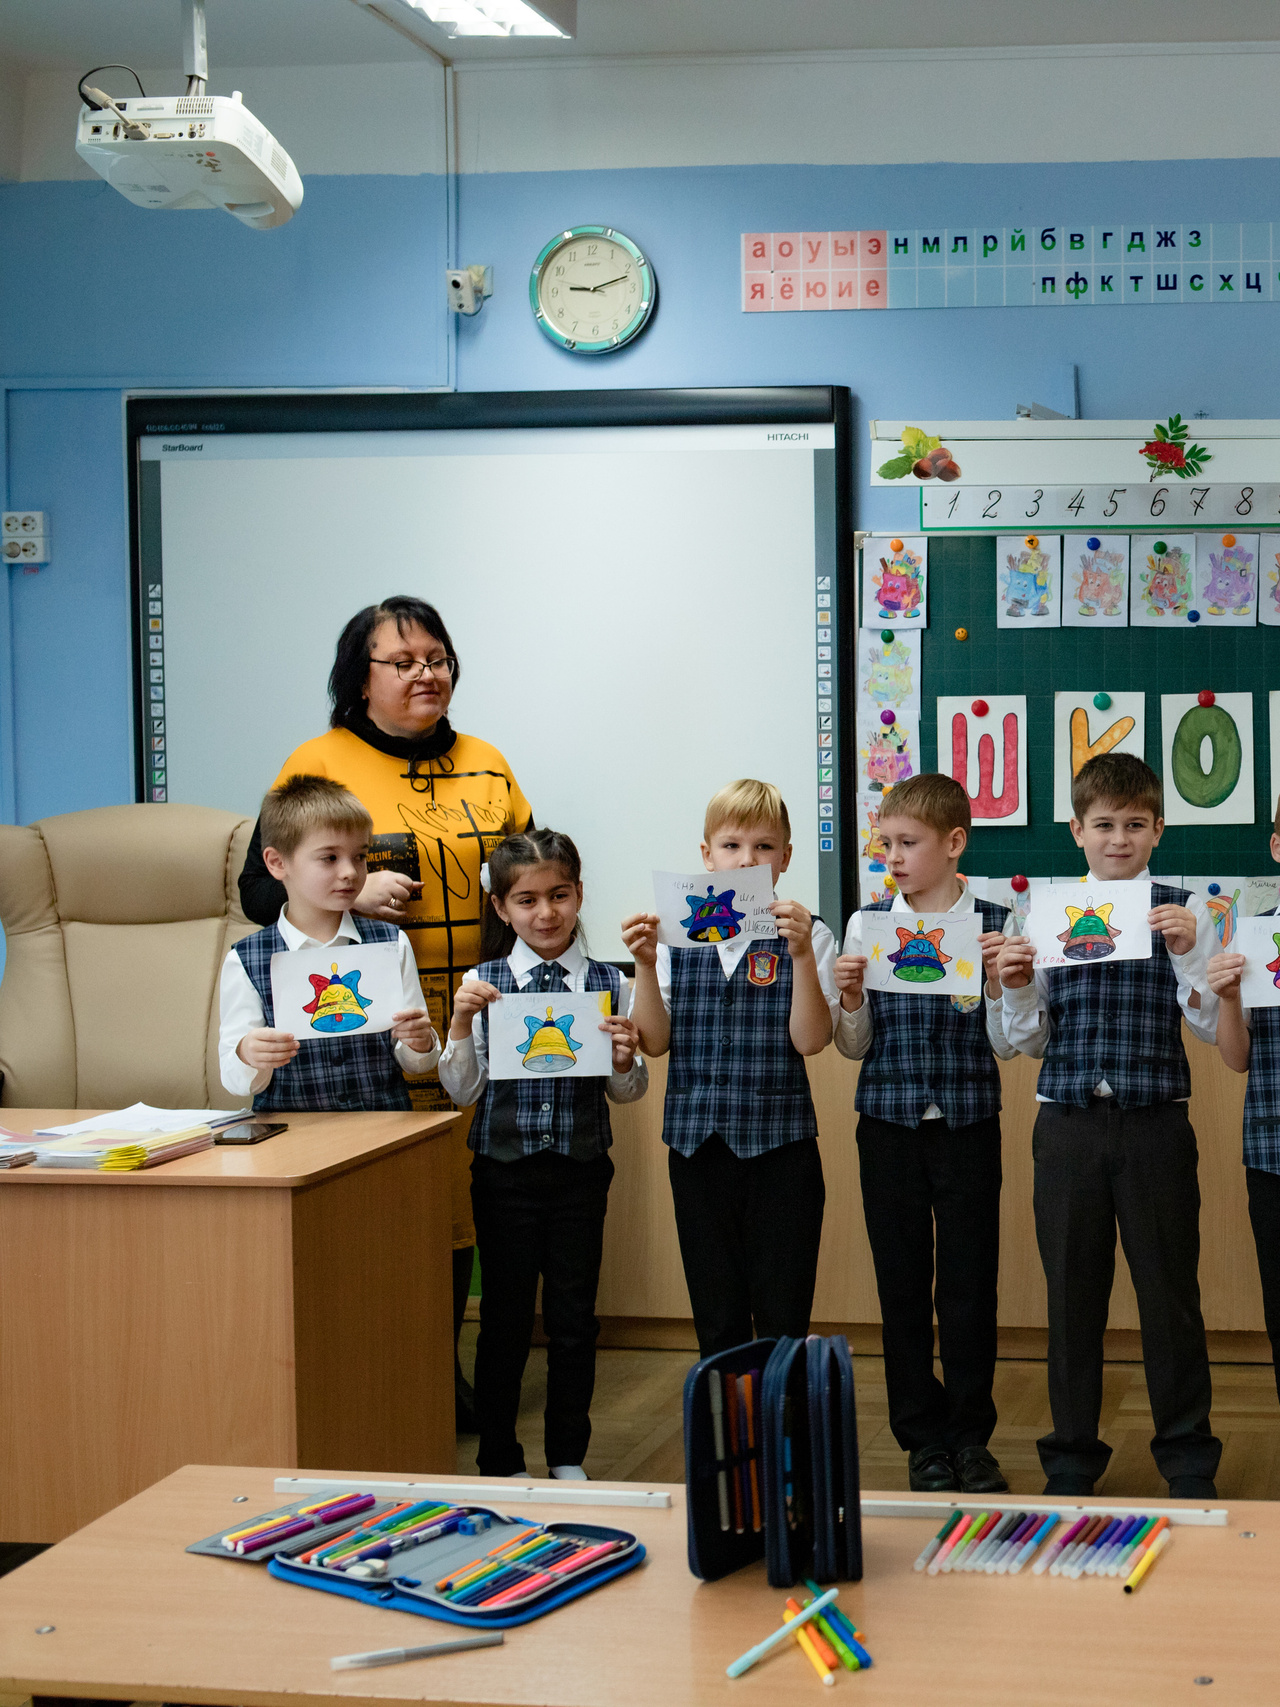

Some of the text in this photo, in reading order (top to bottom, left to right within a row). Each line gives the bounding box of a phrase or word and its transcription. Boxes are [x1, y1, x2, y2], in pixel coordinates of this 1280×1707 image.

[587, 244, 598, 256] 12
[752, 241, 766, 258] а
[778, 241, 793, 258] о
[807, 240, 822, 264] у
[834, 239, 855, 256] ы
[868, 238, 881, 255] э
[894, 237, 908, 254] н
[922, 236, 940, 253] м
[951, 236, 968, 253] л
[983, 235, 998, 257] р
[1010, 228, 1025, 251] й
[1041, 227, 1056, 250] б
[1069, 233, 1085, 250] в
[1102, 232, 1113, 249] г
[1127, 232, 1145, 252] д
[1156, 231, 1176, 248] ж
[1188, 230, 1201, 248] з
[568, 251, 577, 262] 11
[609, 249, 615, 260] 1
[555, 266, 565, 277] 10
[624, 263, 632, 274] 2
[629, 282, 637, 294] 3
[750, 282, 764, 299] я
[779, 277, 794, 300] ё
[805, 280, 827, 298] ю
[838, 280, 853, 298] и
[865, 278, 880, 297] е
[1042, 276, 1056, 293] п
[1065, 271, 1088, 299] ф
[1101, 275, 1113, 292] к
[1130, 275, 1143, 292] т
[1157, 273, 1177, 290] ш
[1189, 274, 1204, 291] с
[1219, 274, 1234, 291] х
[1246, 272, 1261, 293] ц
[551, 286, 559, 298] 9
[557, 307, 565, 319] 8
[624, 304, 631, 315] 4
[571, 321, 579, 333] 7
[611, 319, 619, 330] 5
[591, 325, 600, 336] 6
[767, 432, 809, 441] HITACHI
[161, 443, 204, 452] StarBoard
[947, 490, 961, 519] 1
[982, 490, 1002, 519] 2
[1025, 489, 1044, 518] 3
[1067, 488, 1085, 517] 4
[1103, 488, 1127, 517] 5
[1149, 488, 1169, 517] 6
[1190, 487, 1211, 516] 7
[1235, 487, 1254, 516] 8
